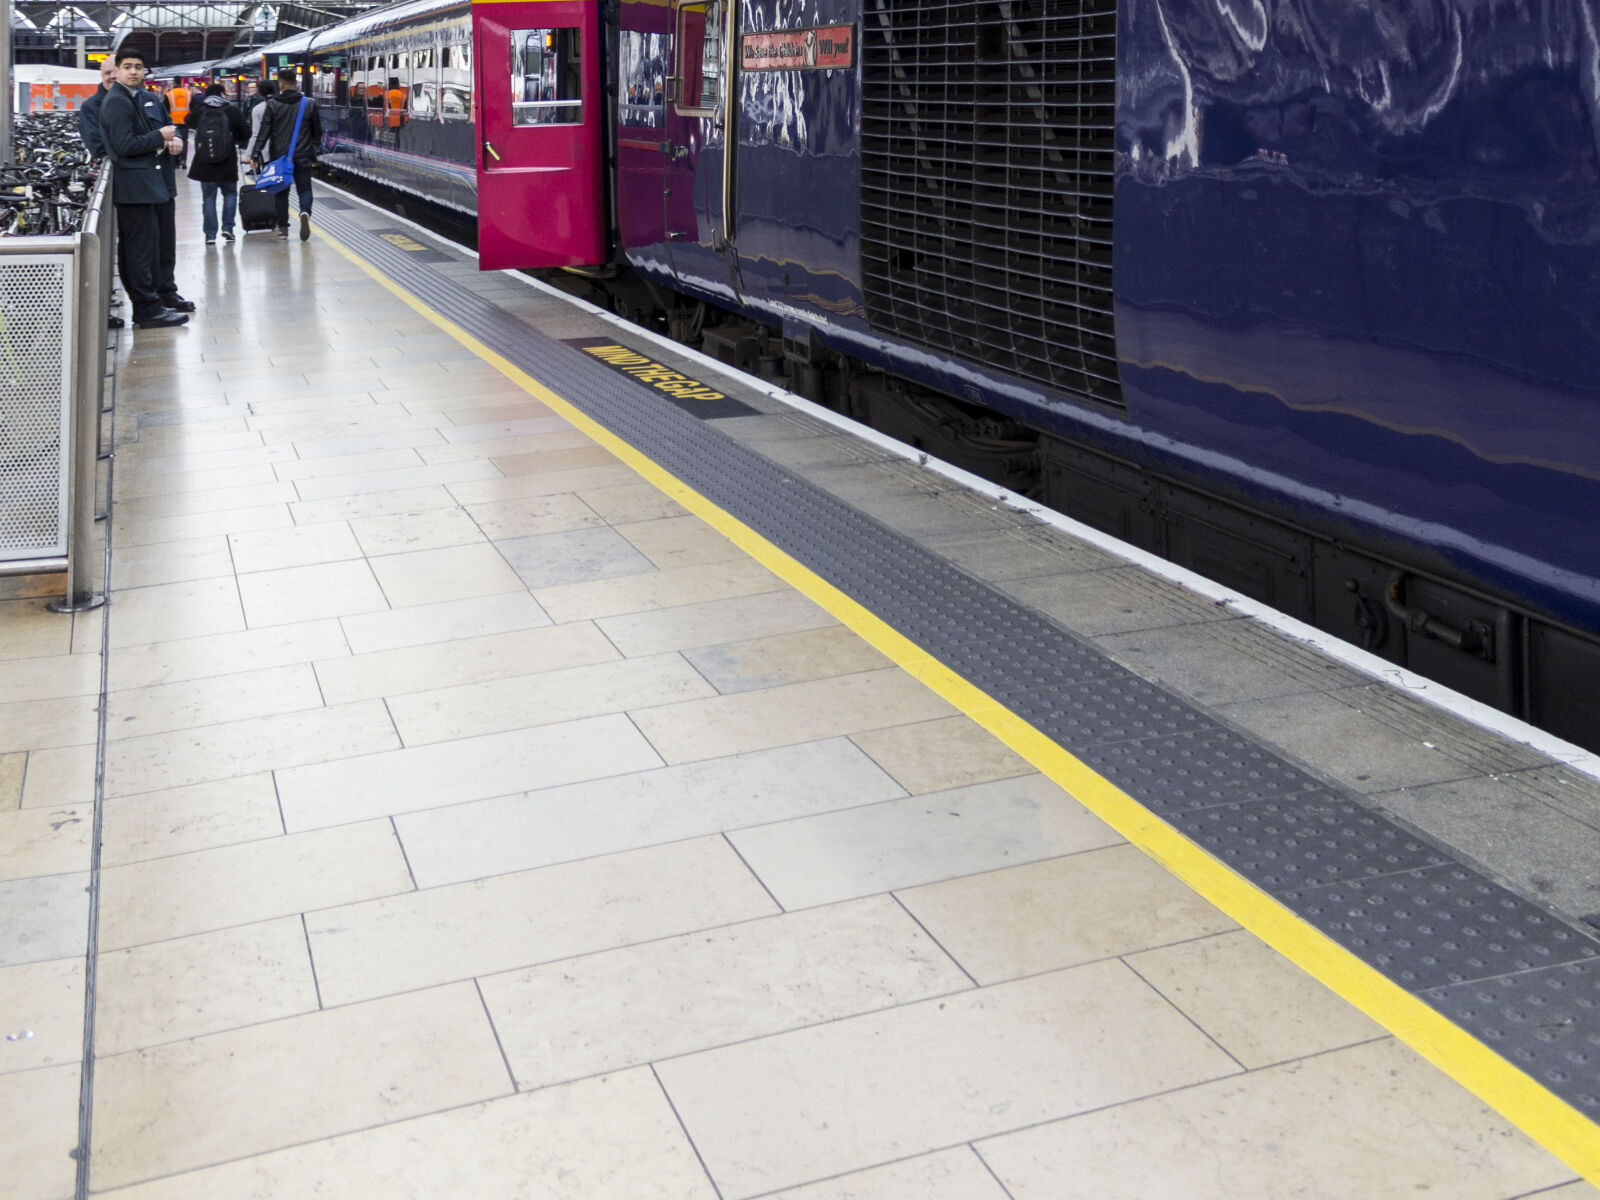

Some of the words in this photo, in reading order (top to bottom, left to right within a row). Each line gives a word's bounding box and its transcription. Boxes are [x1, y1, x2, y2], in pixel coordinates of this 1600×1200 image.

[768, 43, 778, 58] the
[779, 42, 803, 59] Children
[819, 39, 832, 56] Will
[582, 345, 650, 365] MIND
[621, 363, 687, 383] THE
[653, 380, 725, 400] GAP
